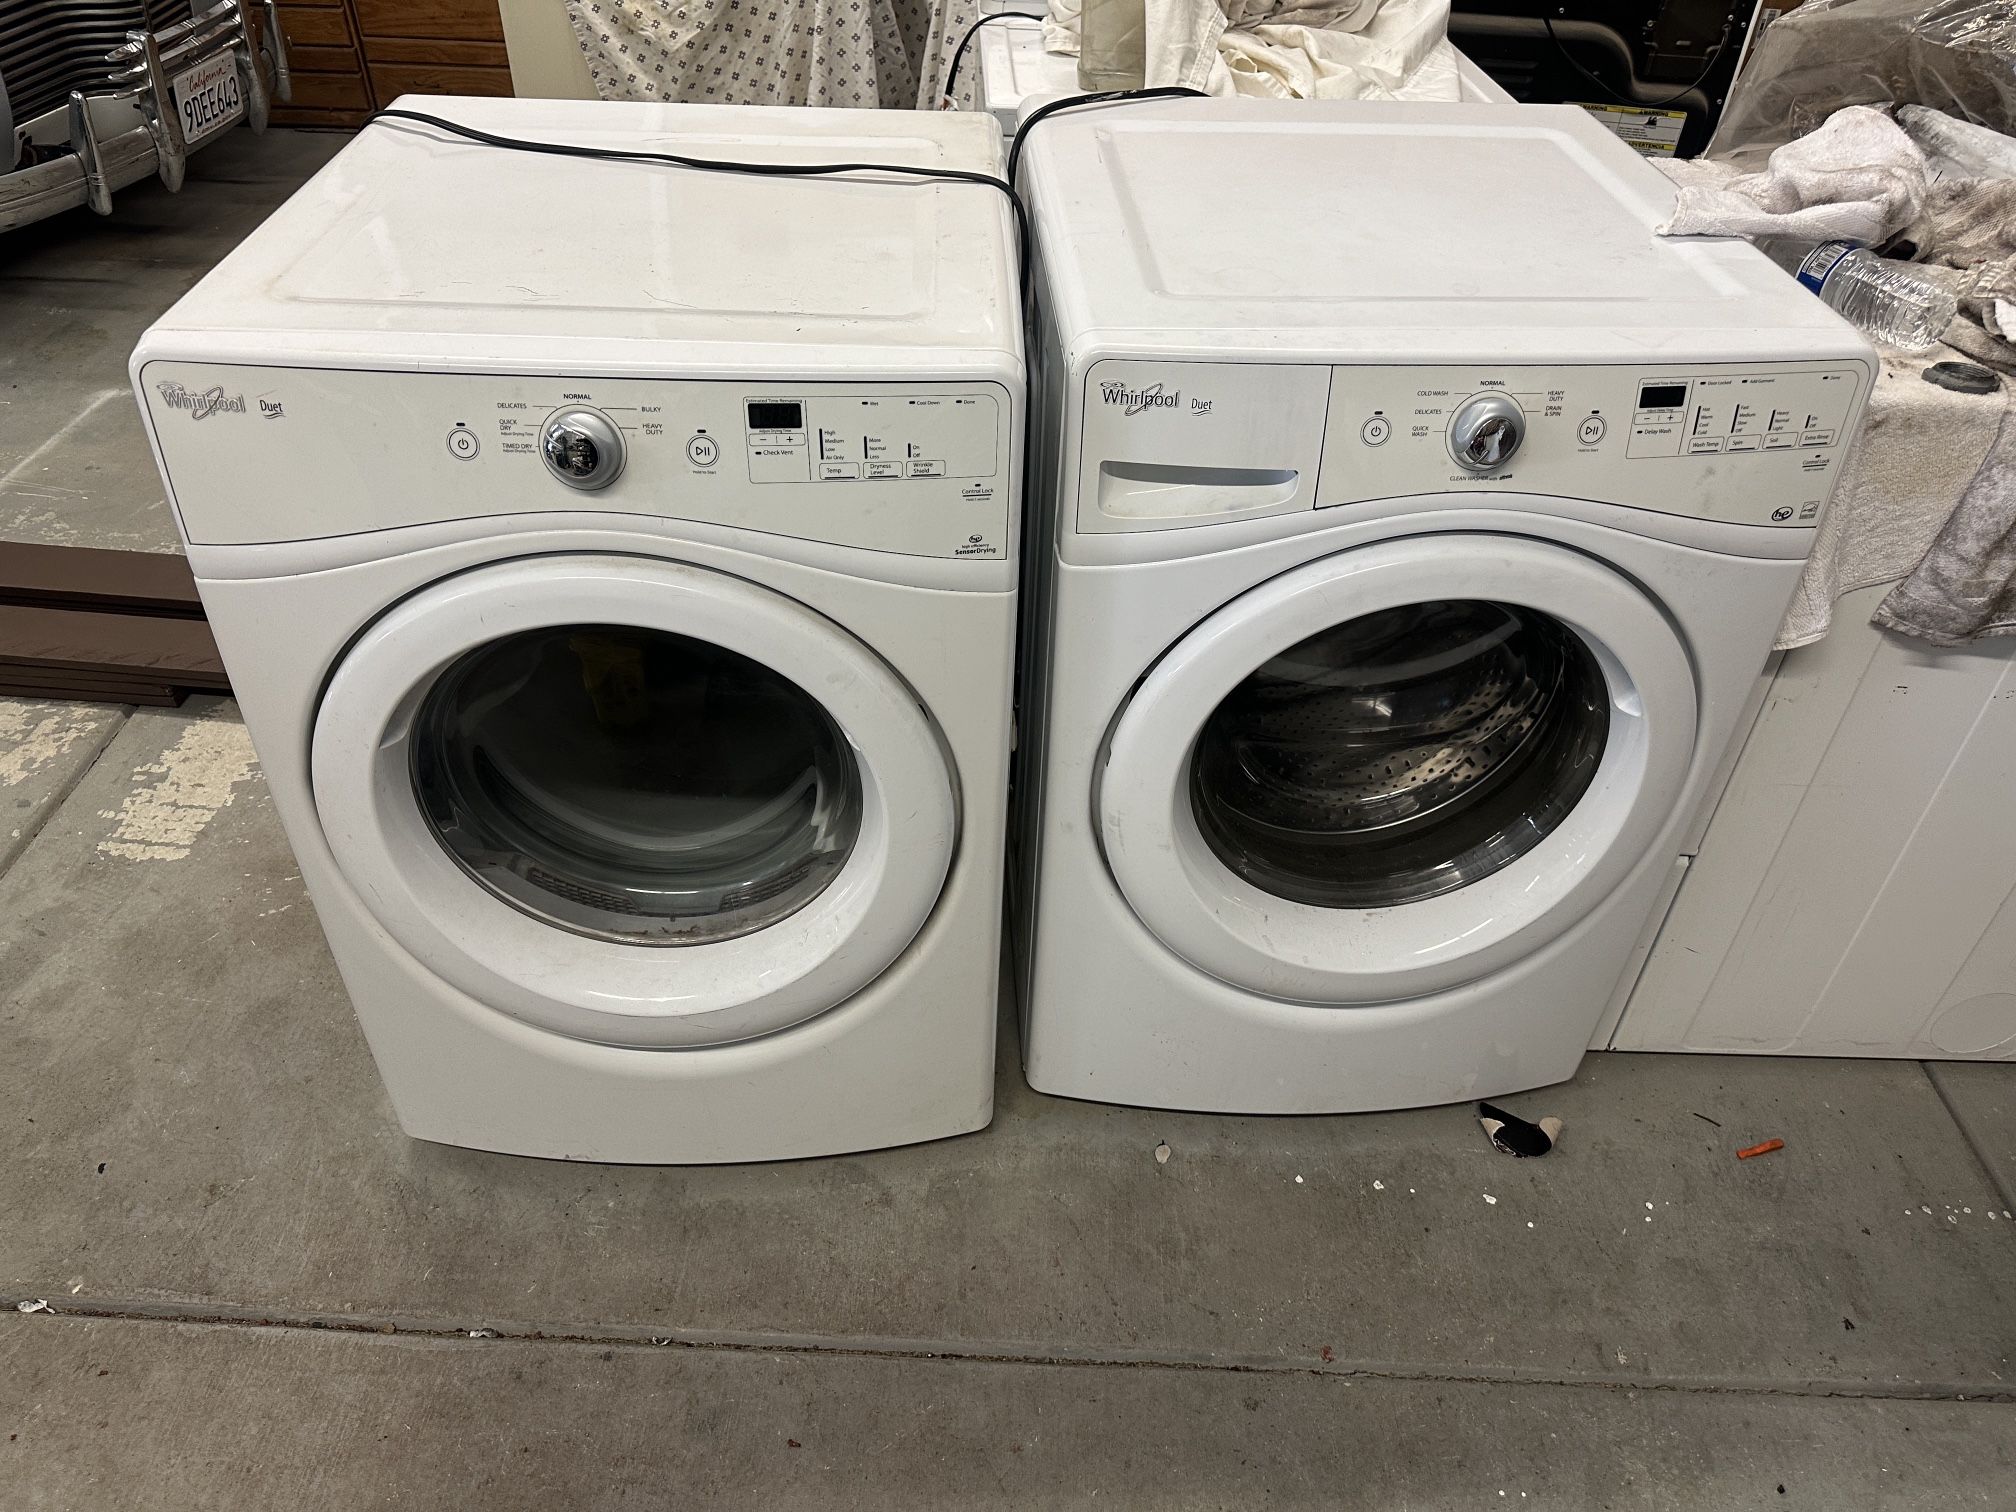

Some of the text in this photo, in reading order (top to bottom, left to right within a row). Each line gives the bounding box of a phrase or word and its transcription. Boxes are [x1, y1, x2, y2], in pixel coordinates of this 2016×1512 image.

[188, 67, 226, 92] California
[183, 76, 239, 132] 9DEE643
[160, 385, 283, 420] Whirlpool Duet
[1103, 383, 1212, 415] Whirlpool Duet
[827, 467, 842, 475] Temp
